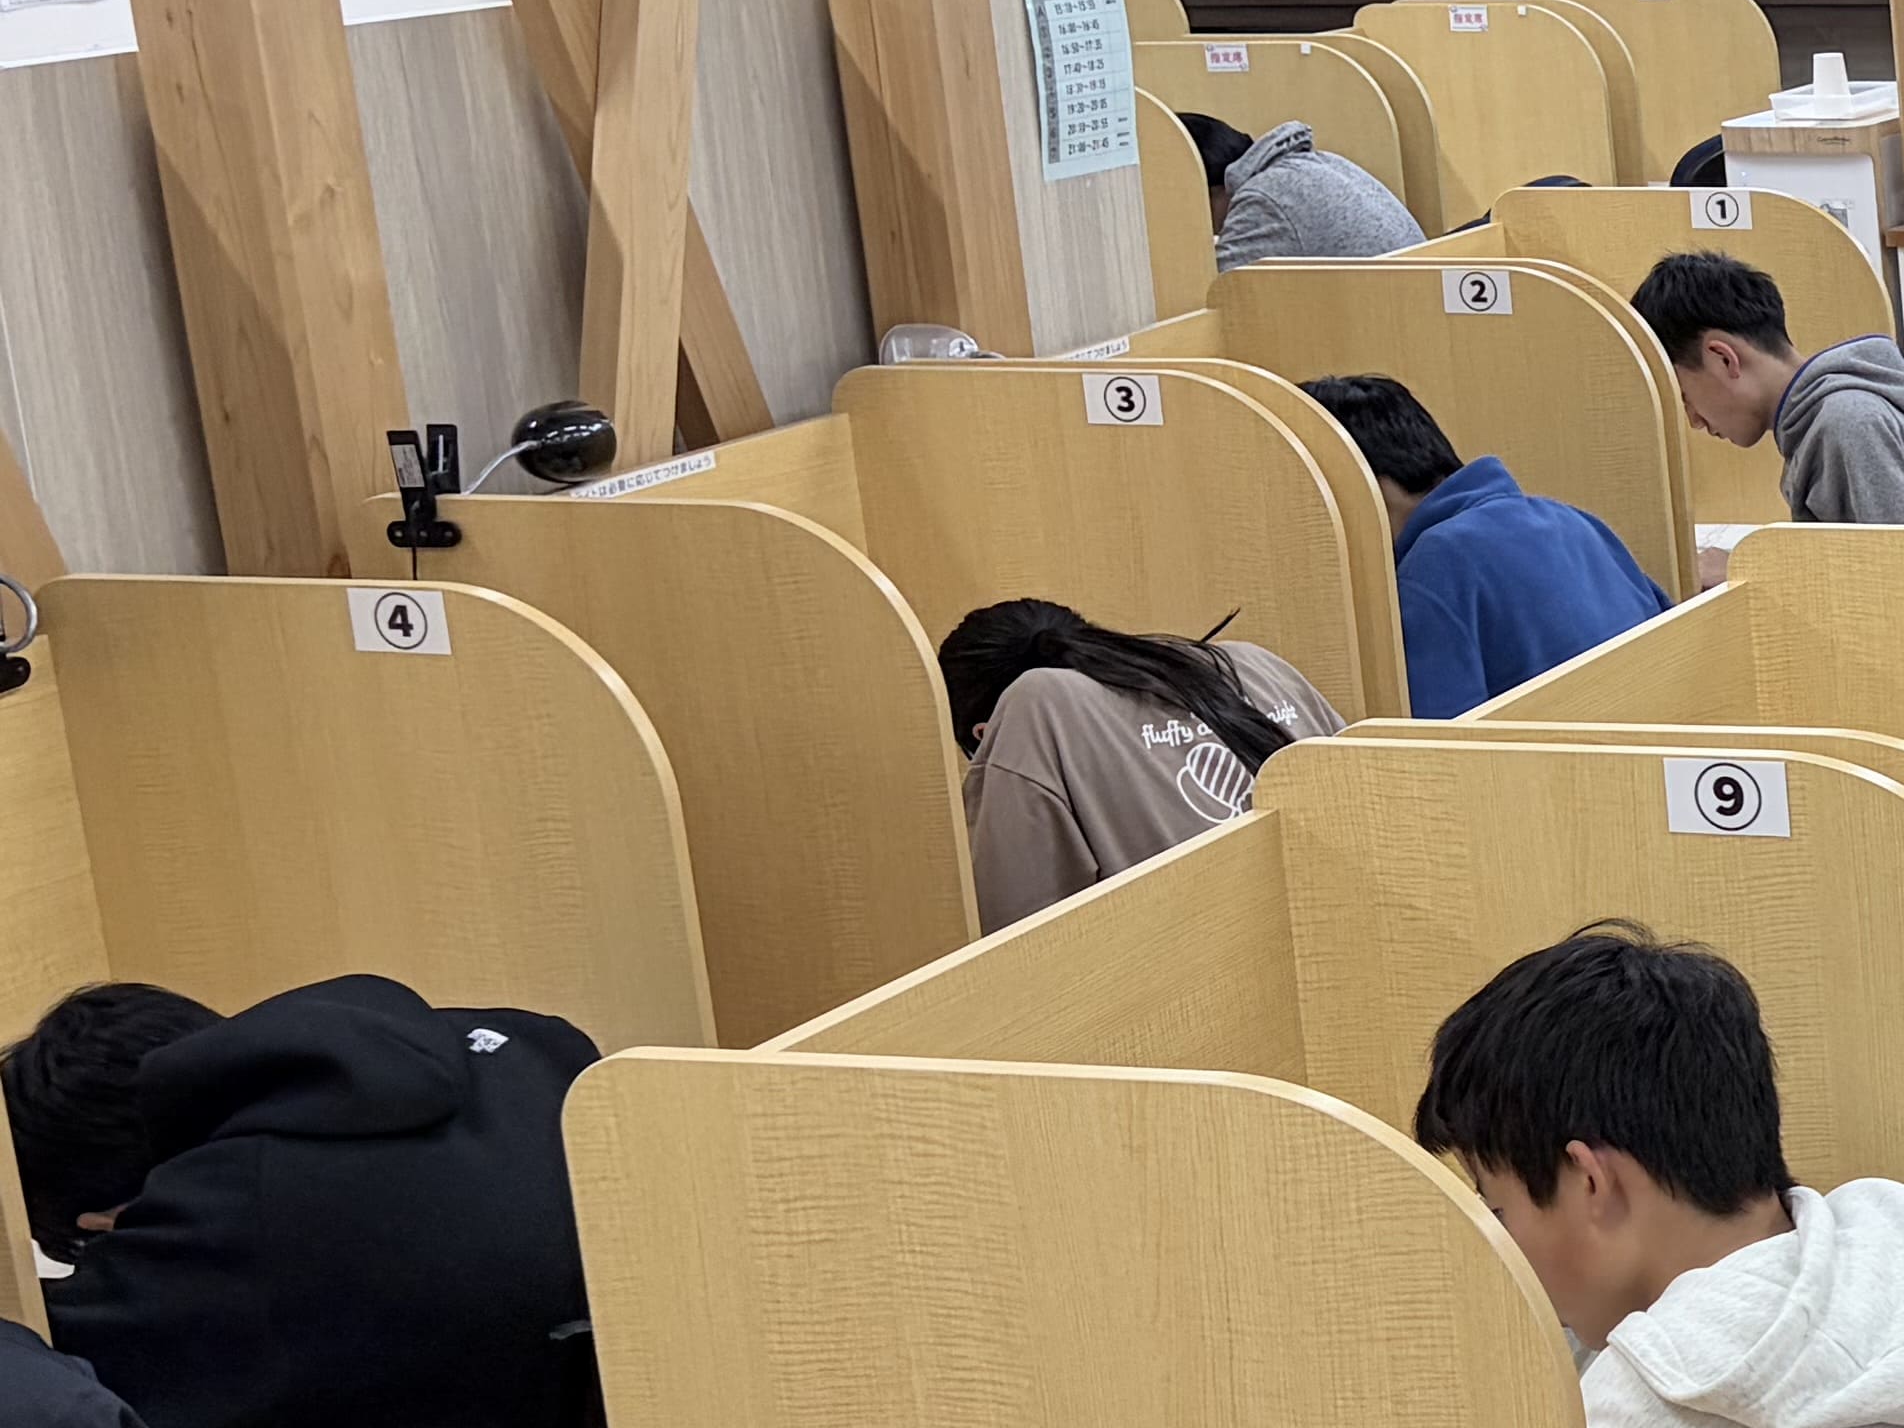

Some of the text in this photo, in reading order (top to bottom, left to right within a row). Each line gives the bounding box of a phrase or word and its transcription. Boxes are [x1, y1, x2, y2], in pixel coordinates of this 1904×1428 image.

[1453, 12, 1484, 27] 指定席
[1209, 50, 1243, 66] 指定席
[1141, 720, 1194, 749] fluffy
